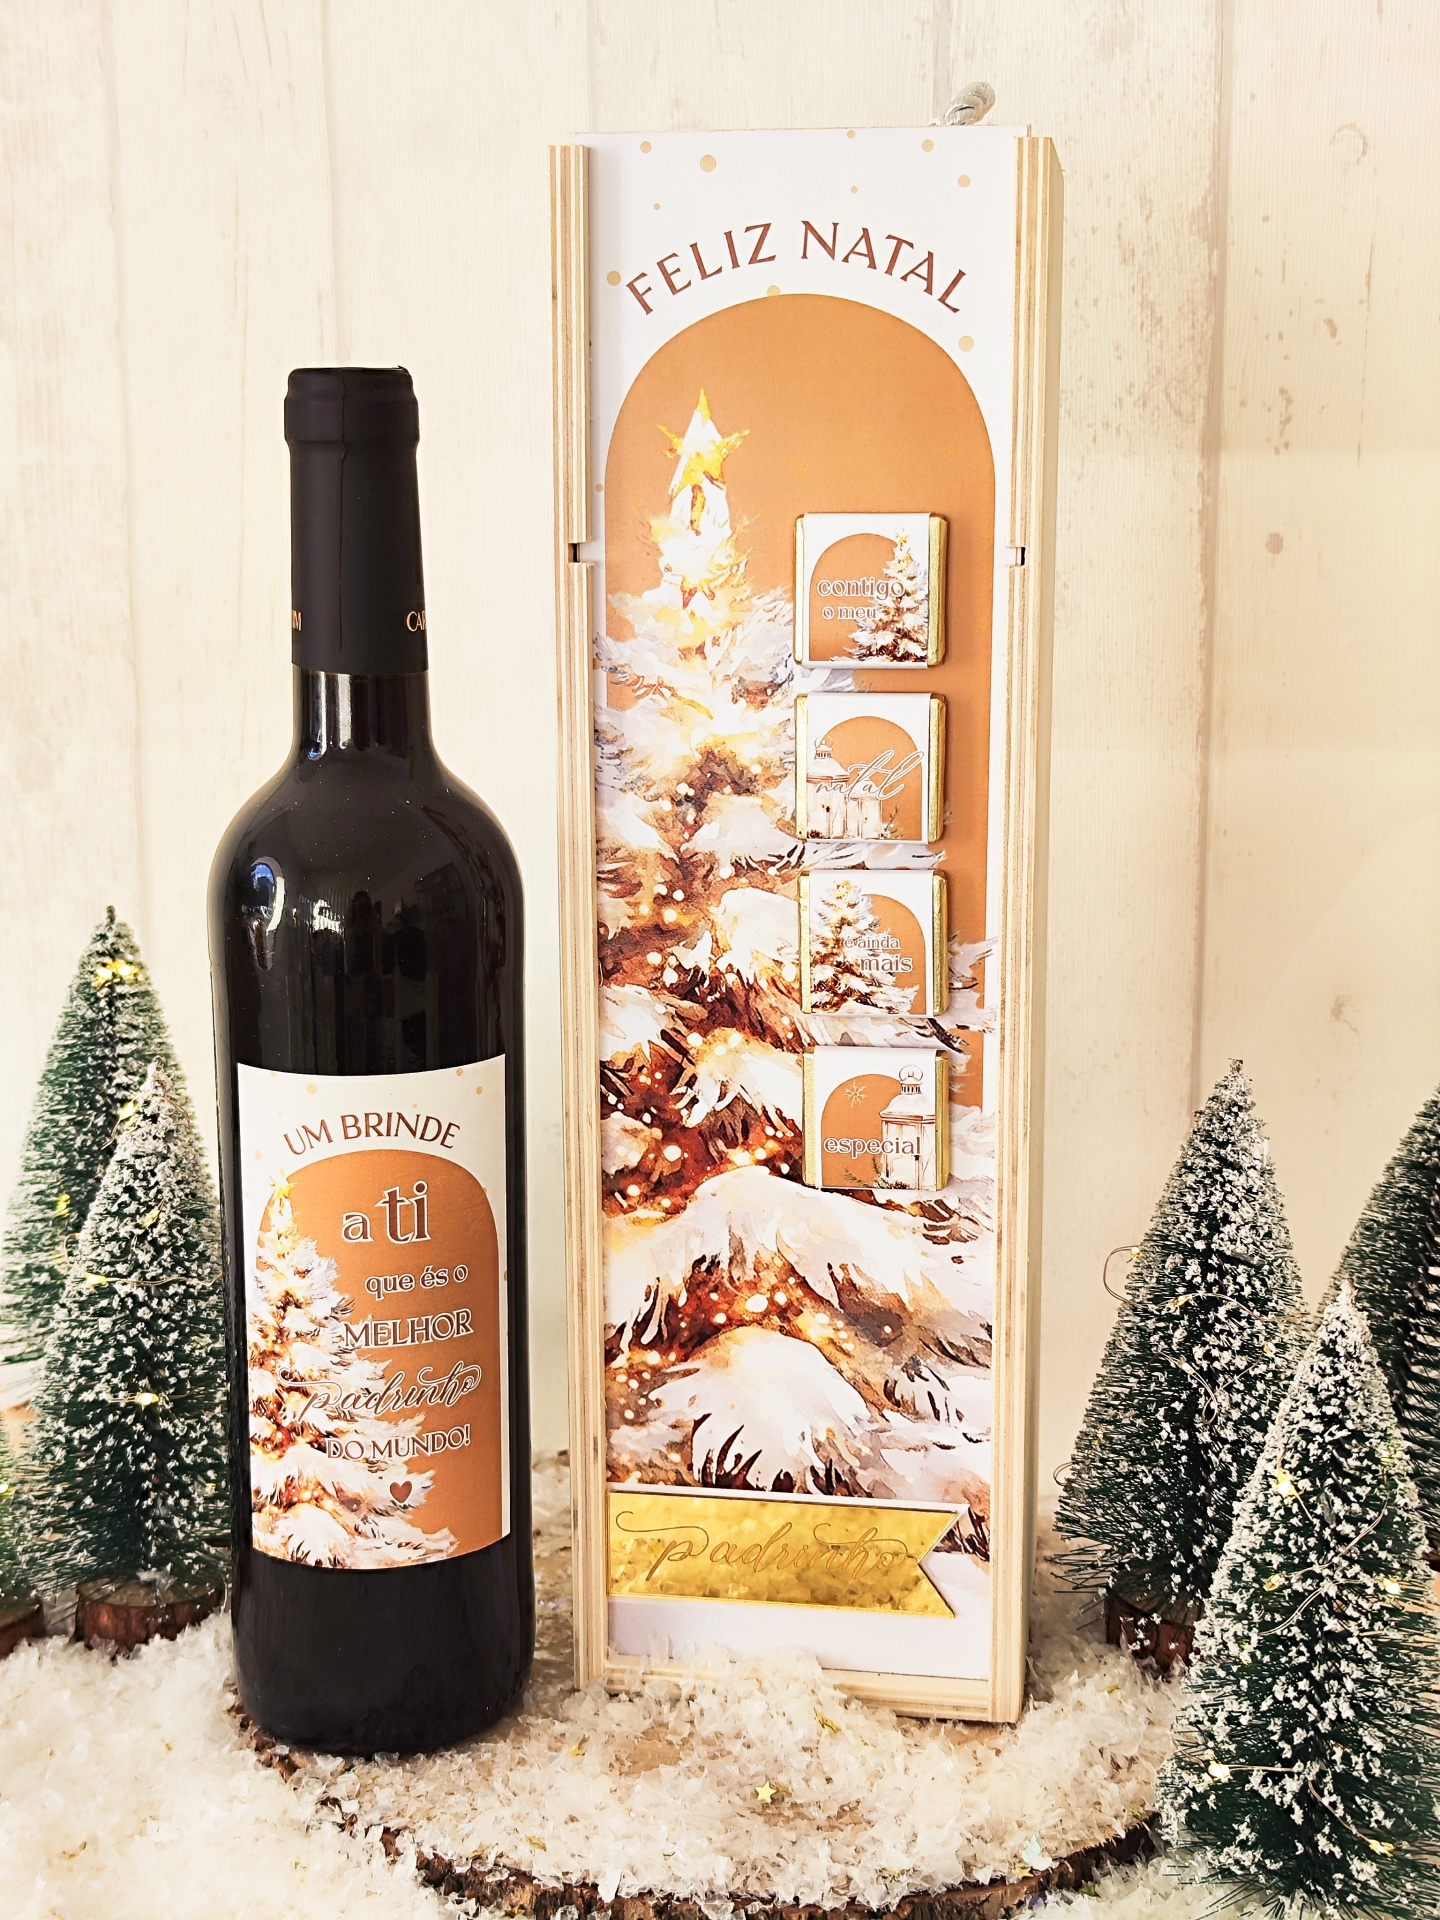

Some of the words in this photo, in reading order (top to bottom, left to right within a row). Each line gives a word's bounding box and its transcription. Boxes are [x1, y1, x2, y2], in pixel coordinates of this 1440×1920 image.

[626, 222, 776, 315] FELIZ
[801, 220, 966, 313] NATAL
[817, 577, 905, 600] contigo
[822, 606, 834, 619] o
[838, 606, 876, 619] meu
[815, 749, 924, 802] natal
[844, 935, 854, 949] é
[857, 935, 900, 949] ainda
[859, 954, 913, 972] mais
[283, 1119, 334, 1155] UM
[340, 1111, 461, 1149] BRINDE
[824, 1136, 921, 1158] especial
[342, 1211, 373, 1243] a
[376, 1181, 431, 1244] ti
[365, 1274, 415, 1300] que
[420, 1266, 448, 1288] és
[454, 1264, 468, 1282] o
[345, 1309, 473, 1348] MELHOR
[278, 1361, 482, 1422] padrinho
[328, 1439, 364, 1459] DO
[372, 1424, 471, 1459] MUNDO!
[615, 1511, 918, 1582] padrinho
